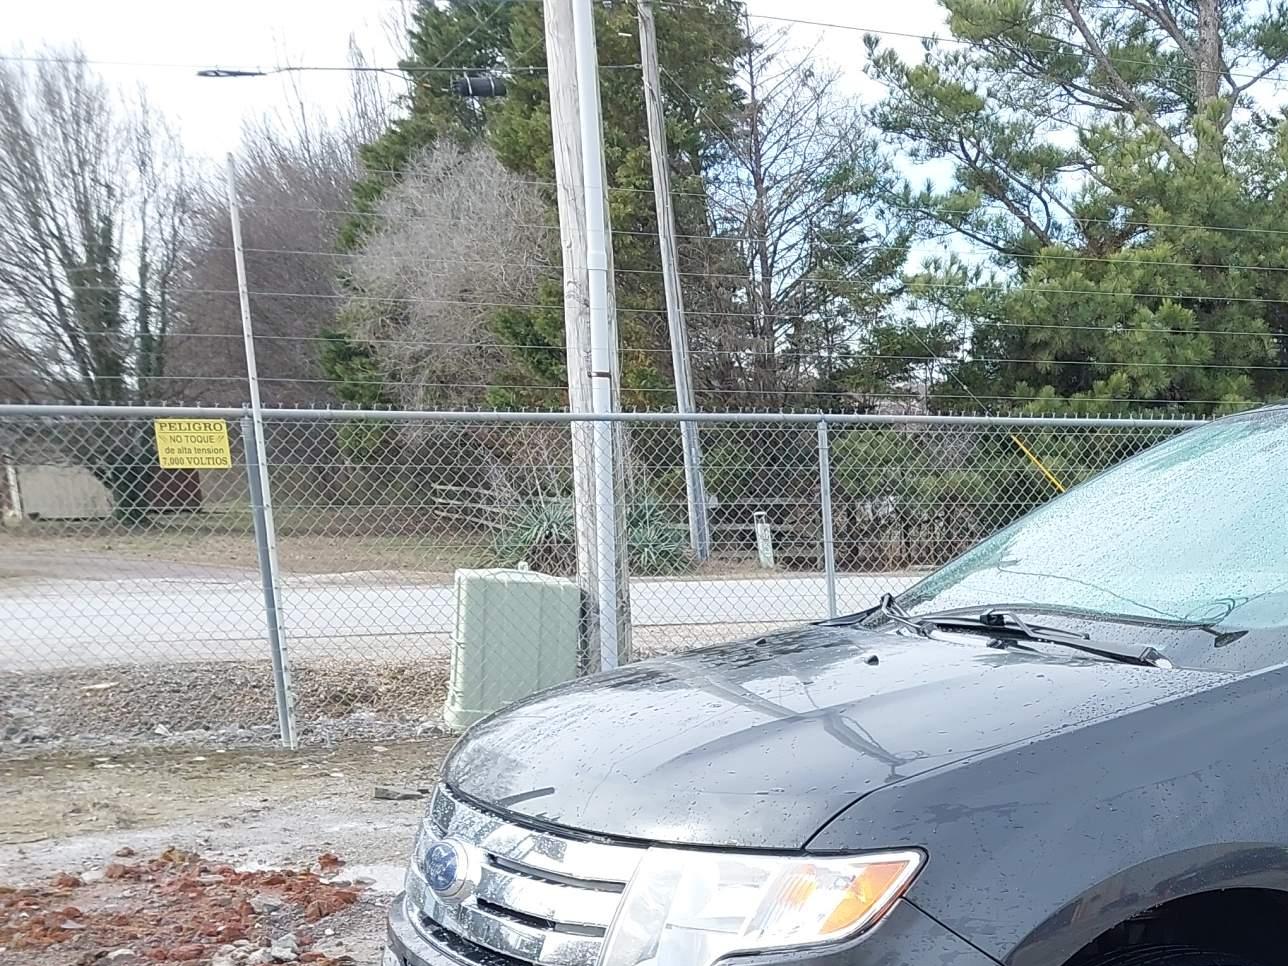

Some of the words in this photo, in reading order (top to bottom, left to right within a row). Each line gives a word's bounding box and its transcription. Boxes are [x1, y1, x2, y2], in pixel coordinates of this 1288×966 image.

[159, 422, 223, 432] PELIGRO
[169, 435, 182, 444] NO
[184, 435, 215, 444] TOQUE
[177, 446, 192, 454] alta
[186, 456, 228, 466] VOLTIOS
